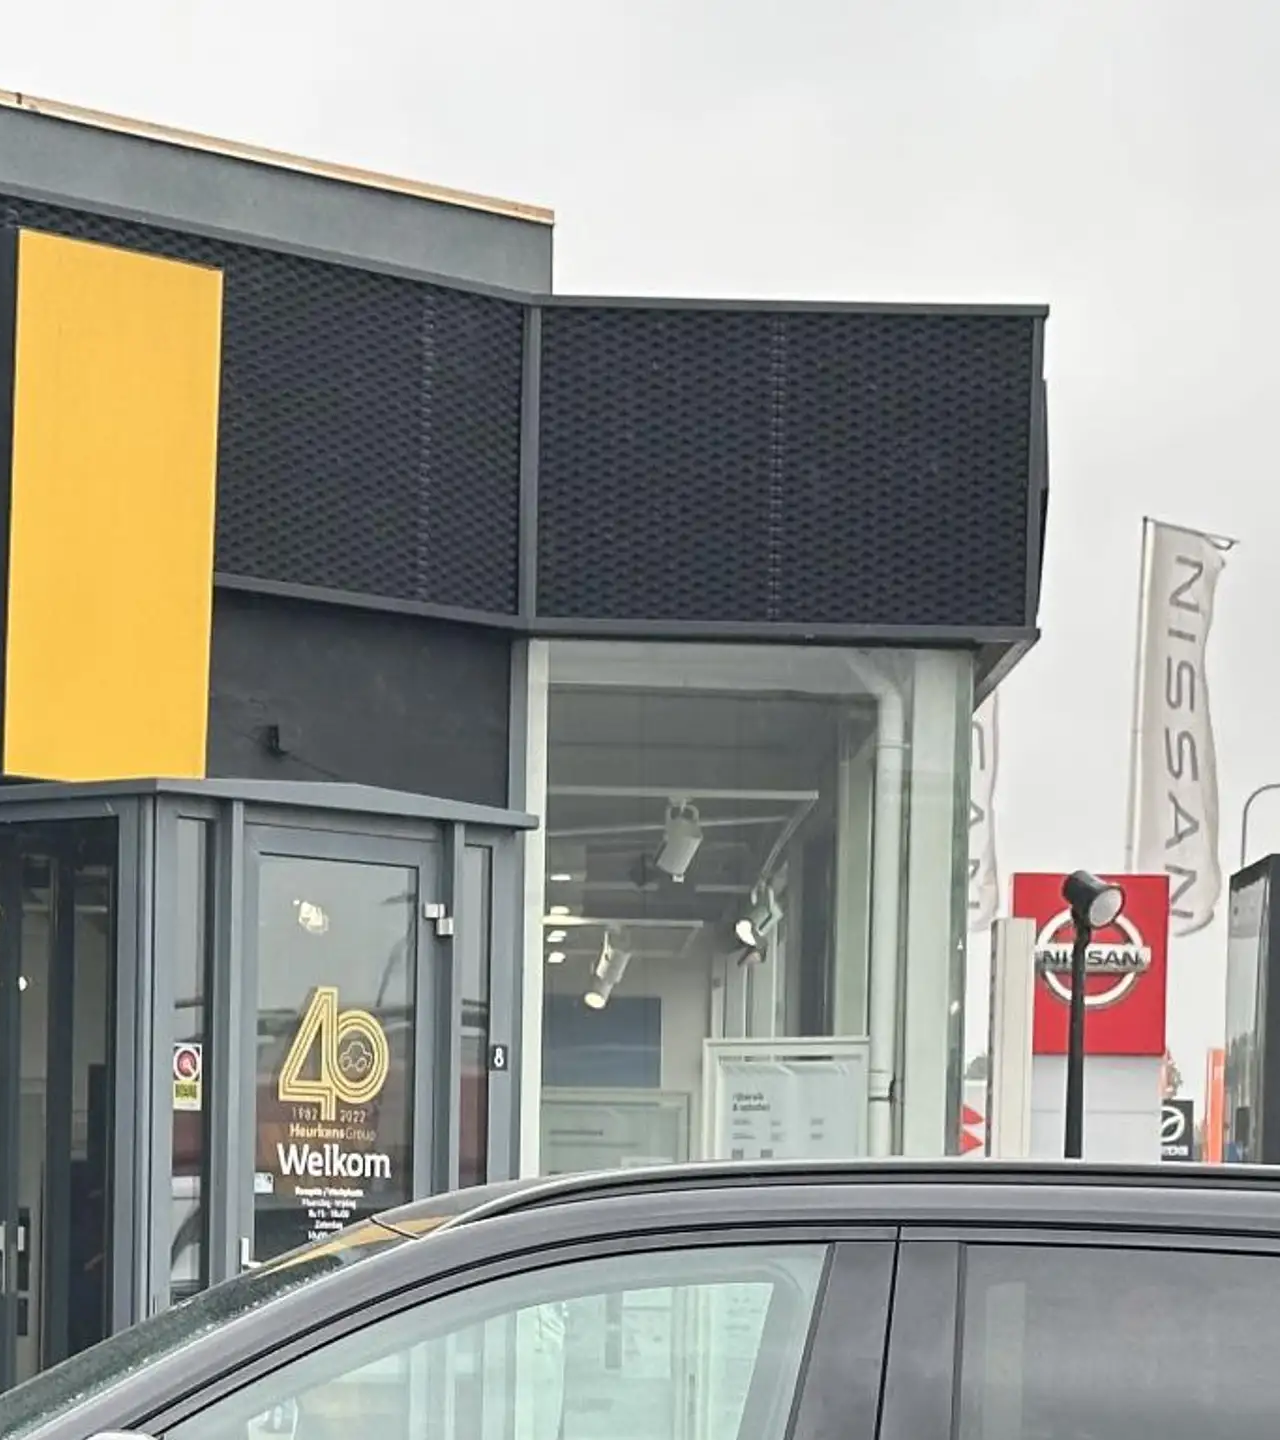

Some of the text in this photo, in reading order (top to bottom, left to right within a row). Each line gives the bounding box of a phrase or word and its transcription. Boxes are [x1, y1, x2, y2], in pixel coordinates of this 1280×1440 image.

[1163, 554, 1206, 919] NISSAN
[1042, 950, 1140, 966] NISAN
[278, 986, 389, 1121] 40
[494, 1047, 504, 1067] 8
[276, 1142, 392, 1179] Welkom
